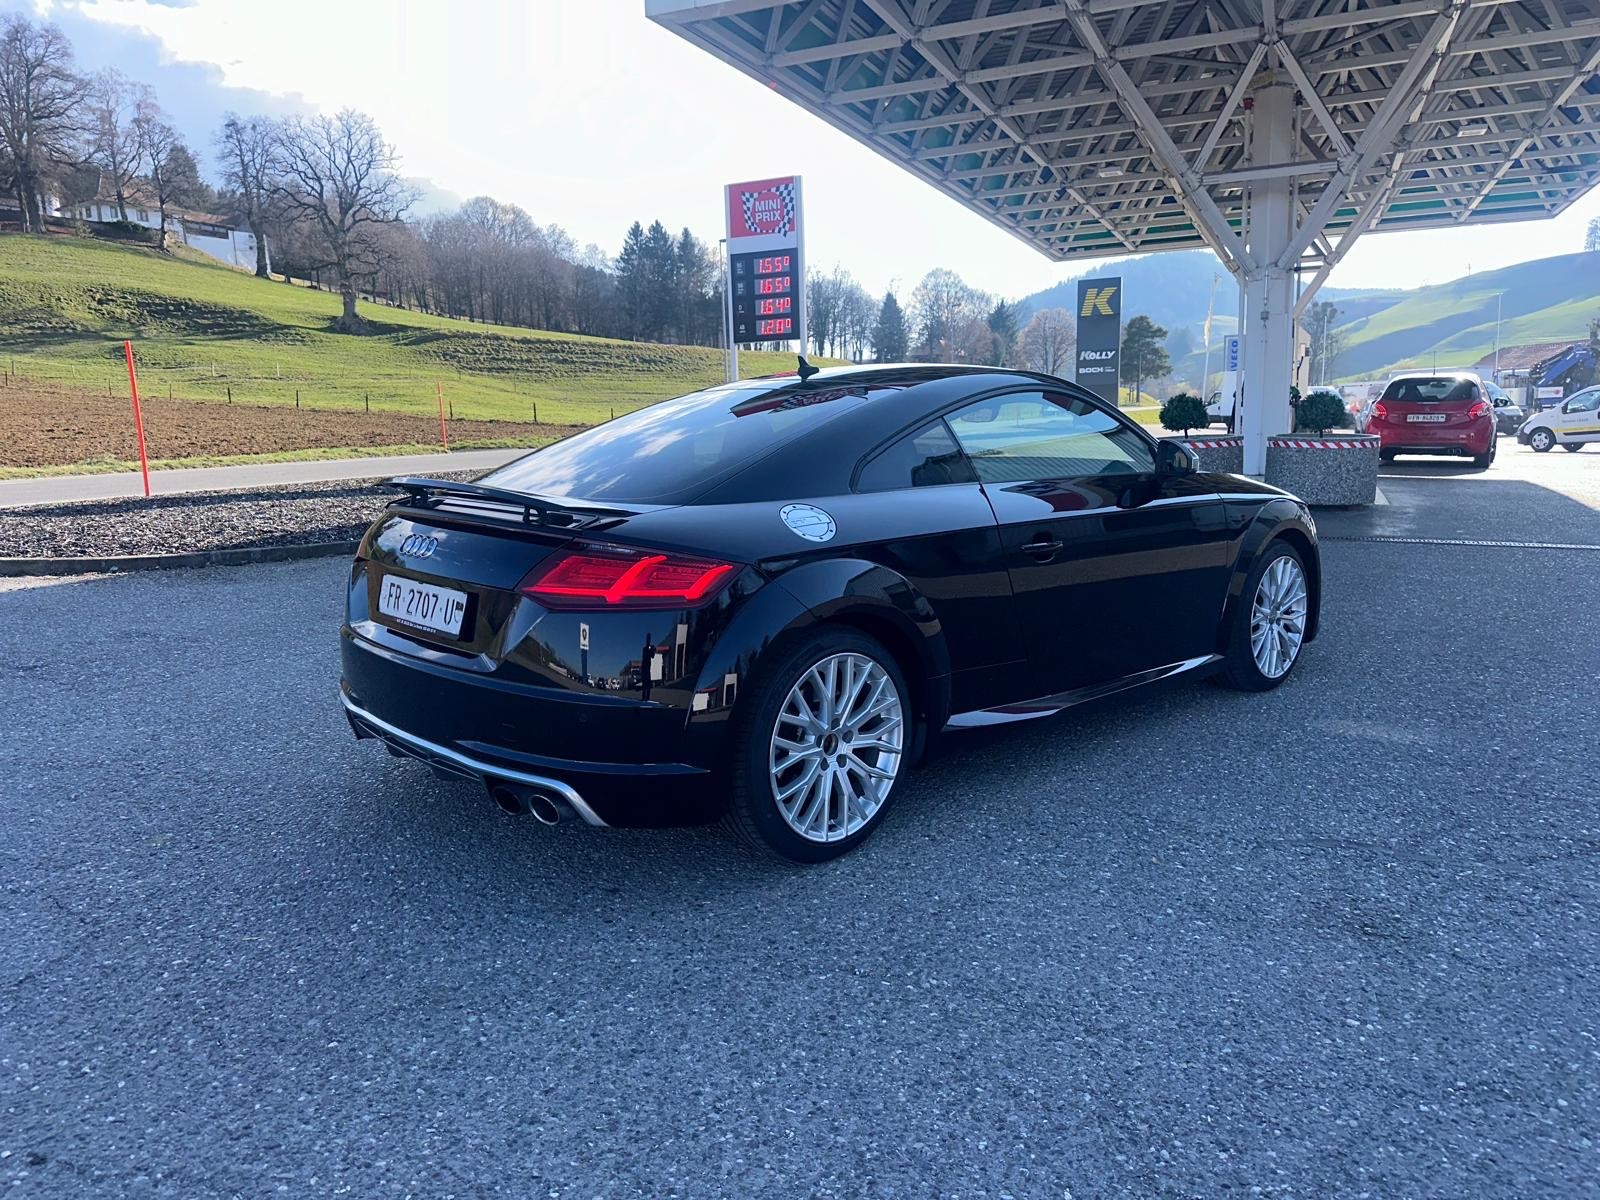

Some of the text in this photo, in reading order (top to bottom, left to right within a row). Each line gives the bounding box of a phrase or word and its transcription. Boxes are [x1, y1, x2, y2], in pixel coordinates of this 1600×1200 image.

[755, 199, 781, 212] MINI
[755, 210, 782, 223] PRIX
[1080, 287, 1118, 317] K
